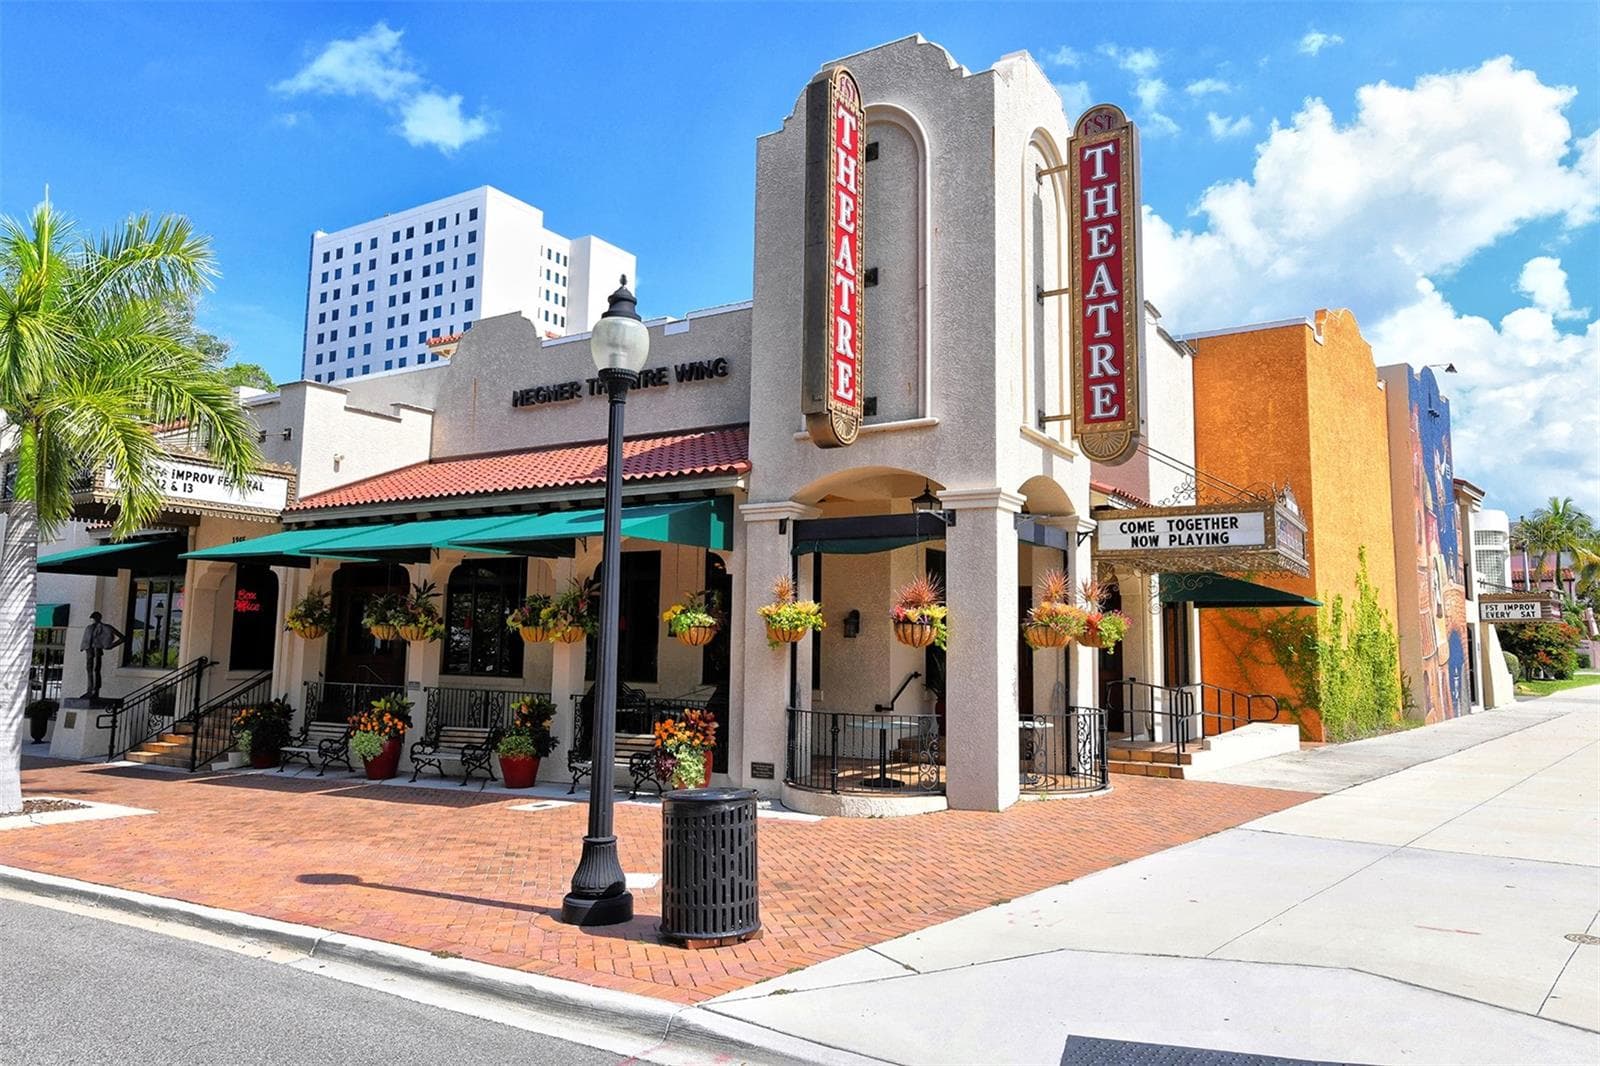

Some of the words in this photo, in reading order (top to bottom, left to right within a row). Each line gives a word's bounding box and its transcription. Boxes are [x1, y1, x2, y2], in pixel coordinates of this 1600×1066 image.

[835, 107, 857, 401] THEATRE
[1083, 141, 1120, 421] THEATRE
[512, 380, 583, 408] HEGNER
[585, 366, 669, 397] THTRE
[674, 357, 729, 383] WING
[171, 468, 215, 485] IMPROV
[170, 480, 178, 492] &
[182, 482, 194, 494] 13
[1119, 520, 1156, 535] COME
[1167, 516, 1239, 532] TOGETHER
[1130, 534, 1160, 548] NOW
[1168, 532, 1230, 547] PLAYING
[1503, 603, 1536, 611] IMPROV
